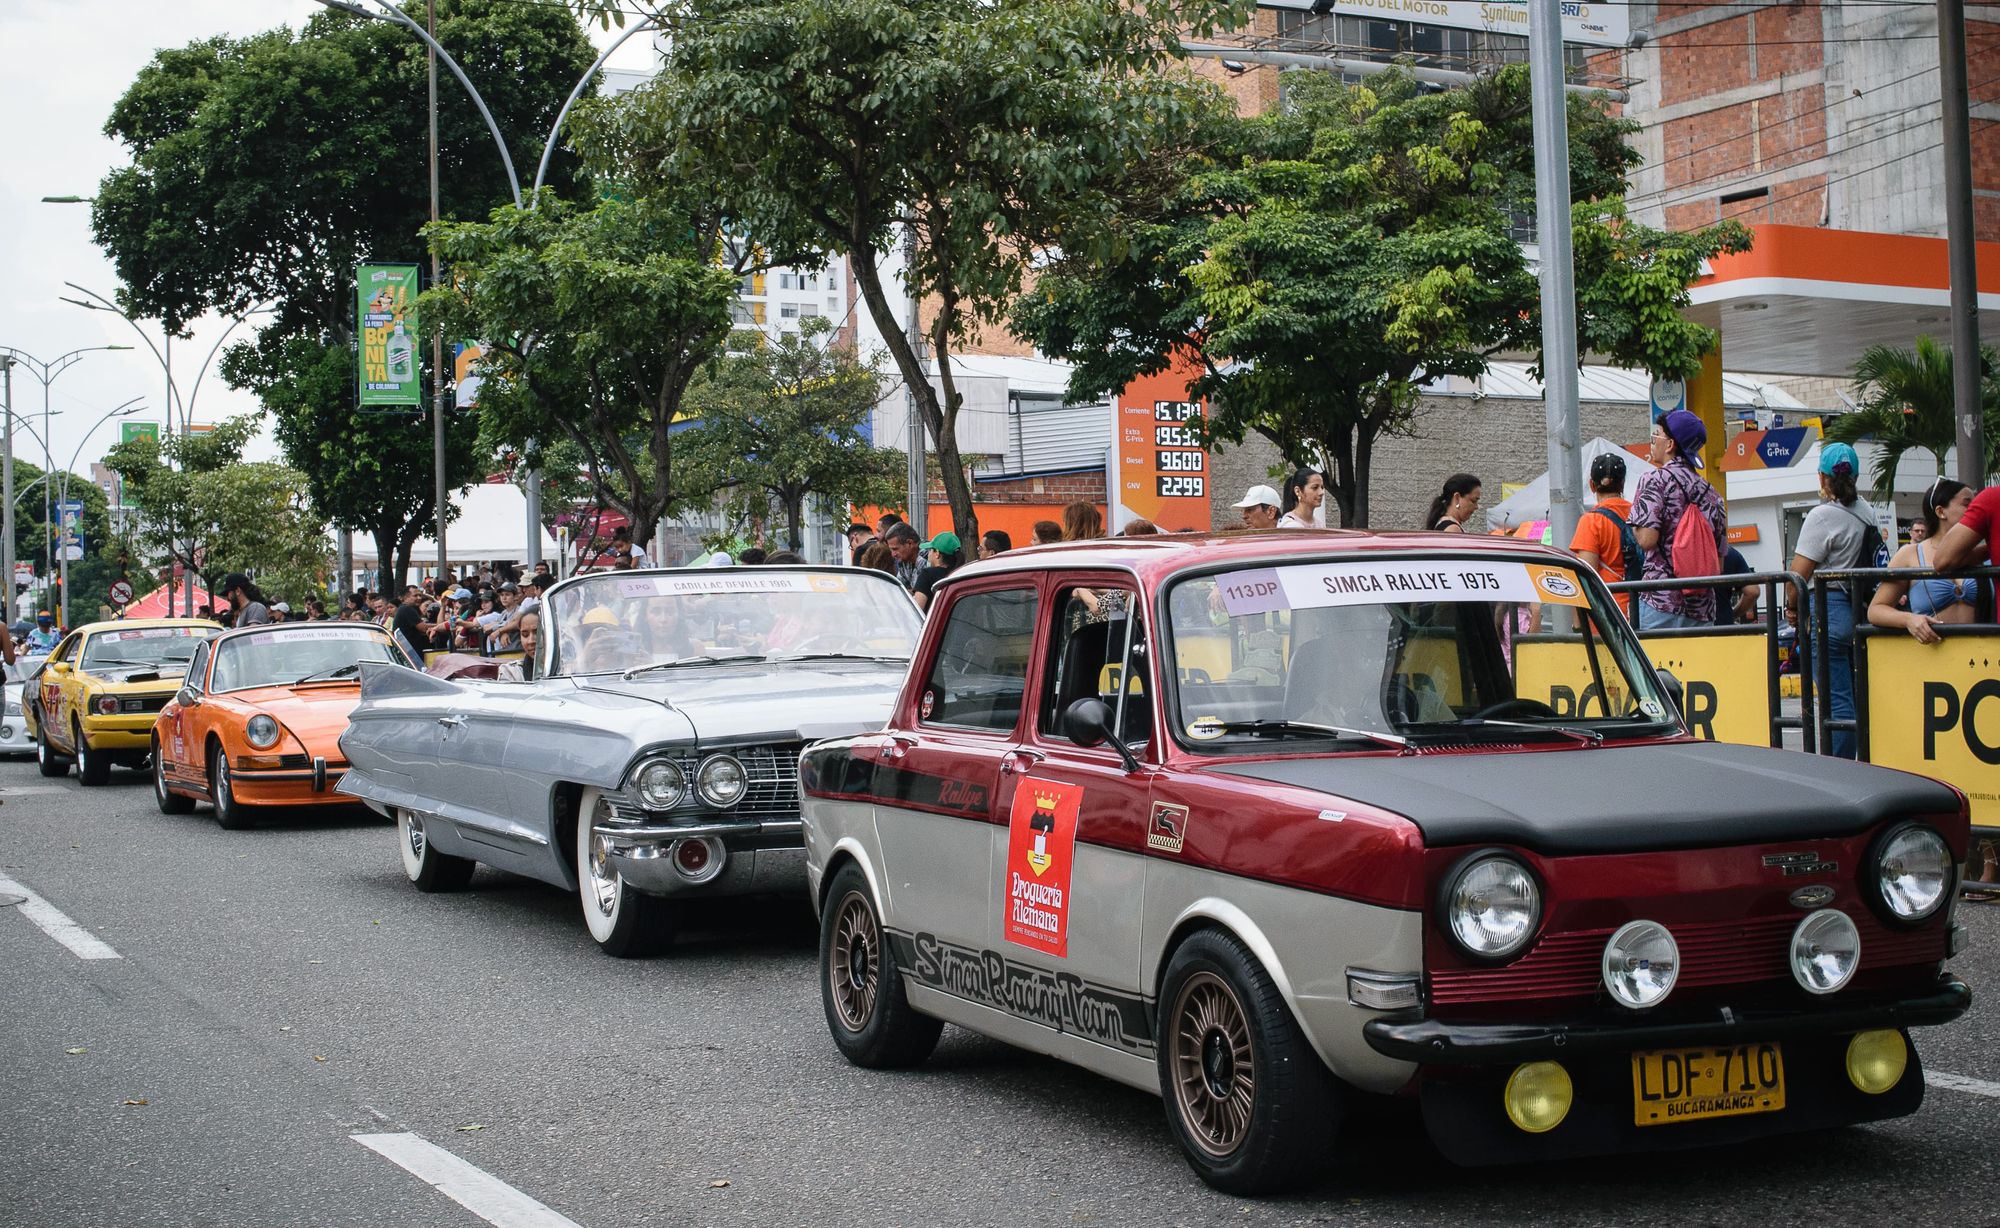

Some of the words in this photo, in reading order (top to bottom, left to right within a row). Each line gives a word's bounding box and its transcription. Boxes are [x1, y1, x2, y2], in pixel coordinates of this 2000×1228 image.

[1403, 2, 1449, 16] MOTOR
[1480, 3, 1528, 24] Syntium
[365, 328, 388, 346] BO
[365, 346, 385, 363] NI
[366, 363, 388, 382] TA
[1657, 393, 1680, 402] icontec
[1124, 407, 1151, 415] Corriente
[1737, 443, 1745, 456] 8
[1767, 448, 1790, 457] G-Prix
[1126, 457, 1144, 465] Diesel
[627, 584, 633, 592] 3
[673, 581, 722, 591] CADILLAC
[726, 580, 767, 590] DEVILLE
[769, 580, 793, 589] 1961
[1322, 575, 1383, 595] SIMCA
[1388, 571, 1452, 593] RALLYE
[1457, 571, 1501, 591] 1975
[284, 632, 316, 640] PORSCHE
[317, 632, 339, 640] TARGA
[1646, 702, 1659, 715] 13
[938, 779, 984, 812] Rallye
[1969, 792, 1997, 801] PERJUDICIAL
[1011, 871, 1063, 909] Droguería
[1012, 898, 1059, 933] Alemana
[1639, 1052, 1704, 1101] LDF
[1714, 1045, 1778, 1093] 710
[1667, 1095, 1755, 1117] BUCARAMANGA
